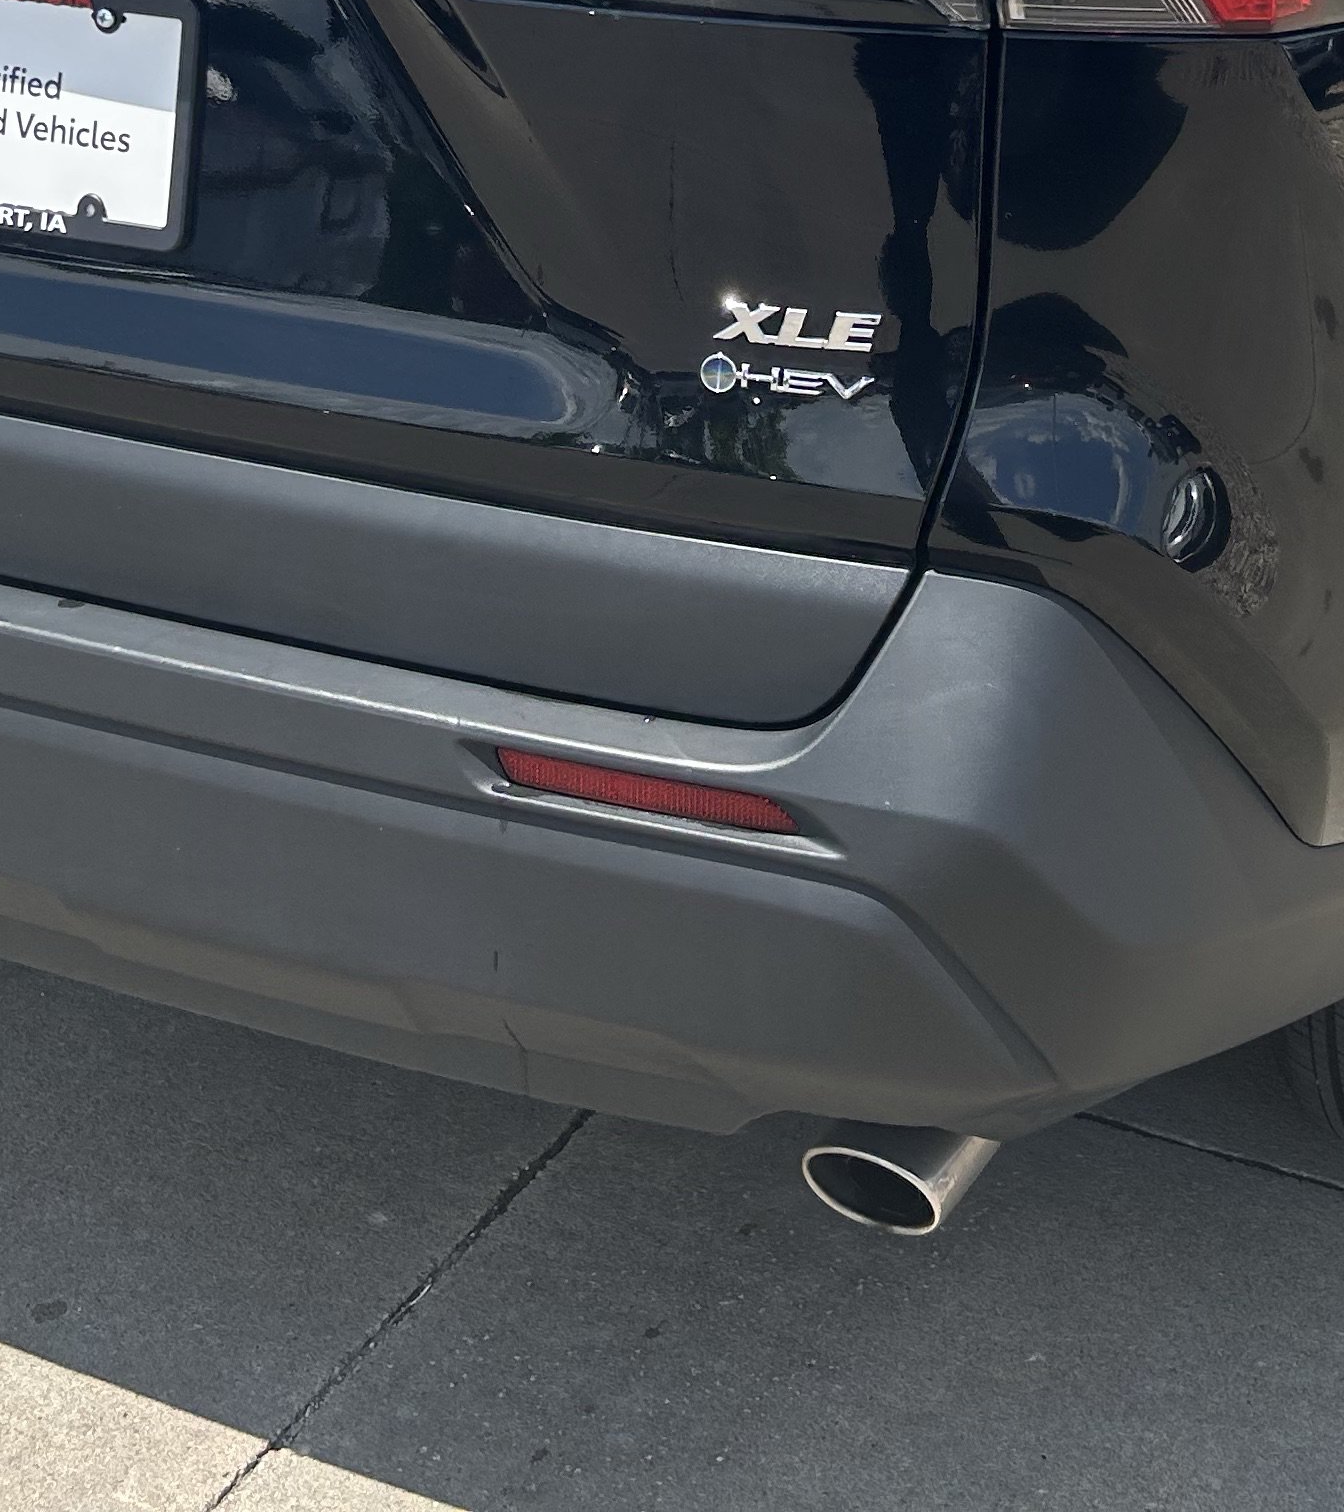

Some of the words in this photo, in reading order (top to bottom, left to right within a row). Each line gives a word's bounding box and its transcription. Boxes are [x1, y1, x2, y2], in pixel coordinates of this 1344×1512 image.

[16, 111, 131, 153] Vehicles
[40, 211, 68, 234] IA
[712, 297, 882, 353] XLE
[737, 362, 875, 400] HEV
